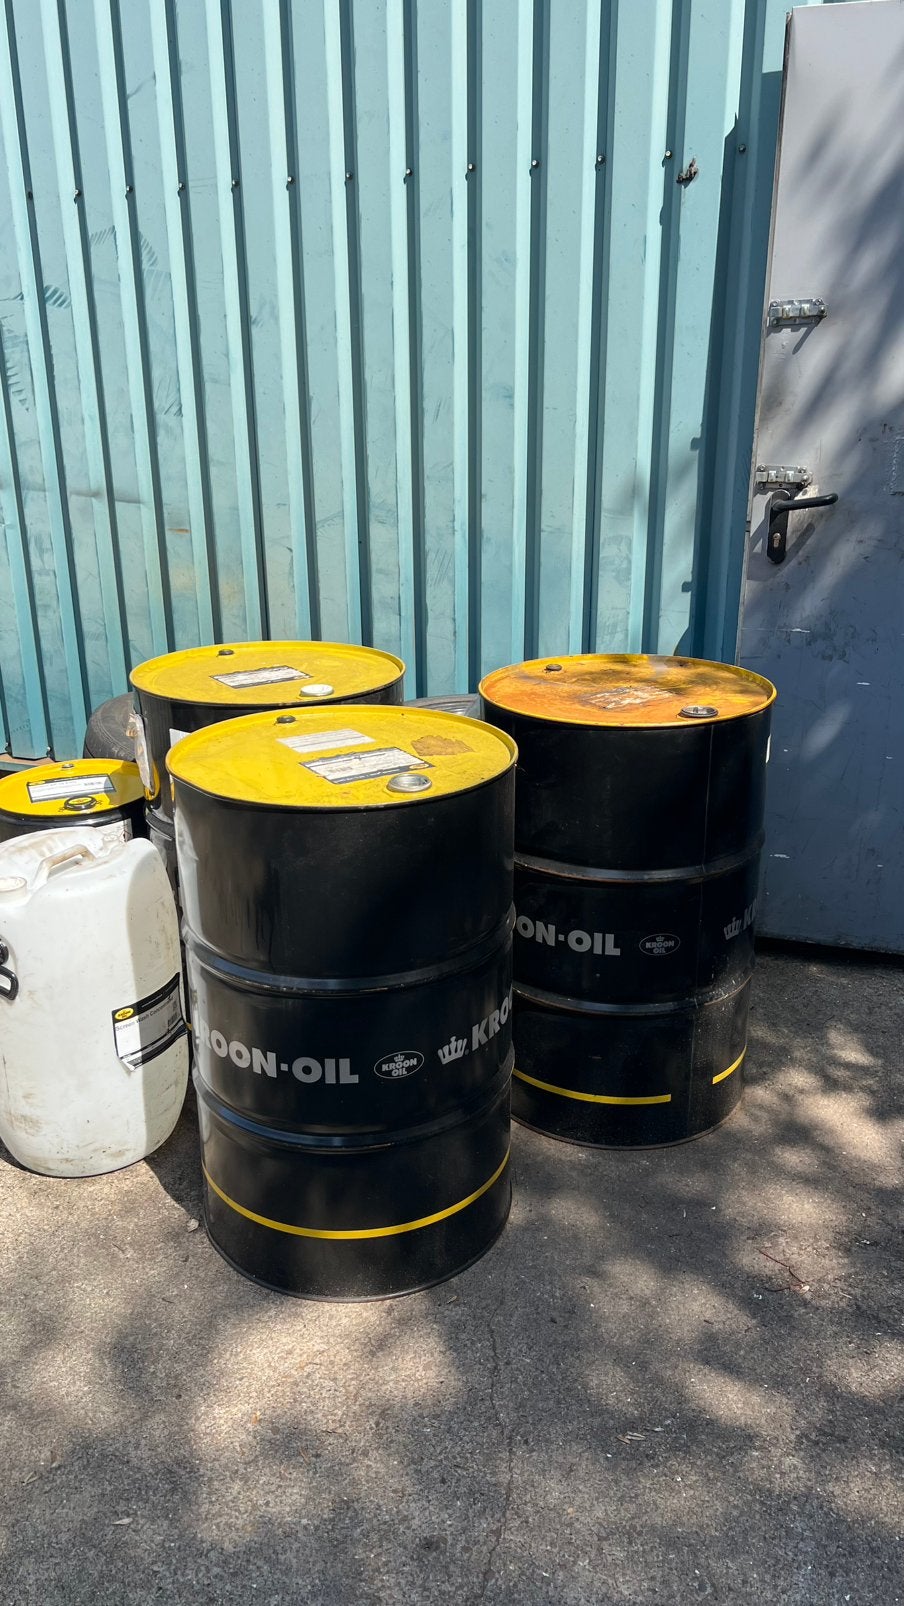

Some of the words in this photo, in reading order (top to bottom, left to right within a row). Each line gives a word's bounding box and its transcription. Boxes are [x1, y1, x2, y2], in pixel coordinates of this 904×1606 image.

[645, 940, 675, 949] KROON
[196, 1014, 359, 1084] ROON-OIL
[381, 1057, 418, 1072] KROON
[391, 1067, 408, 1077] OIL
